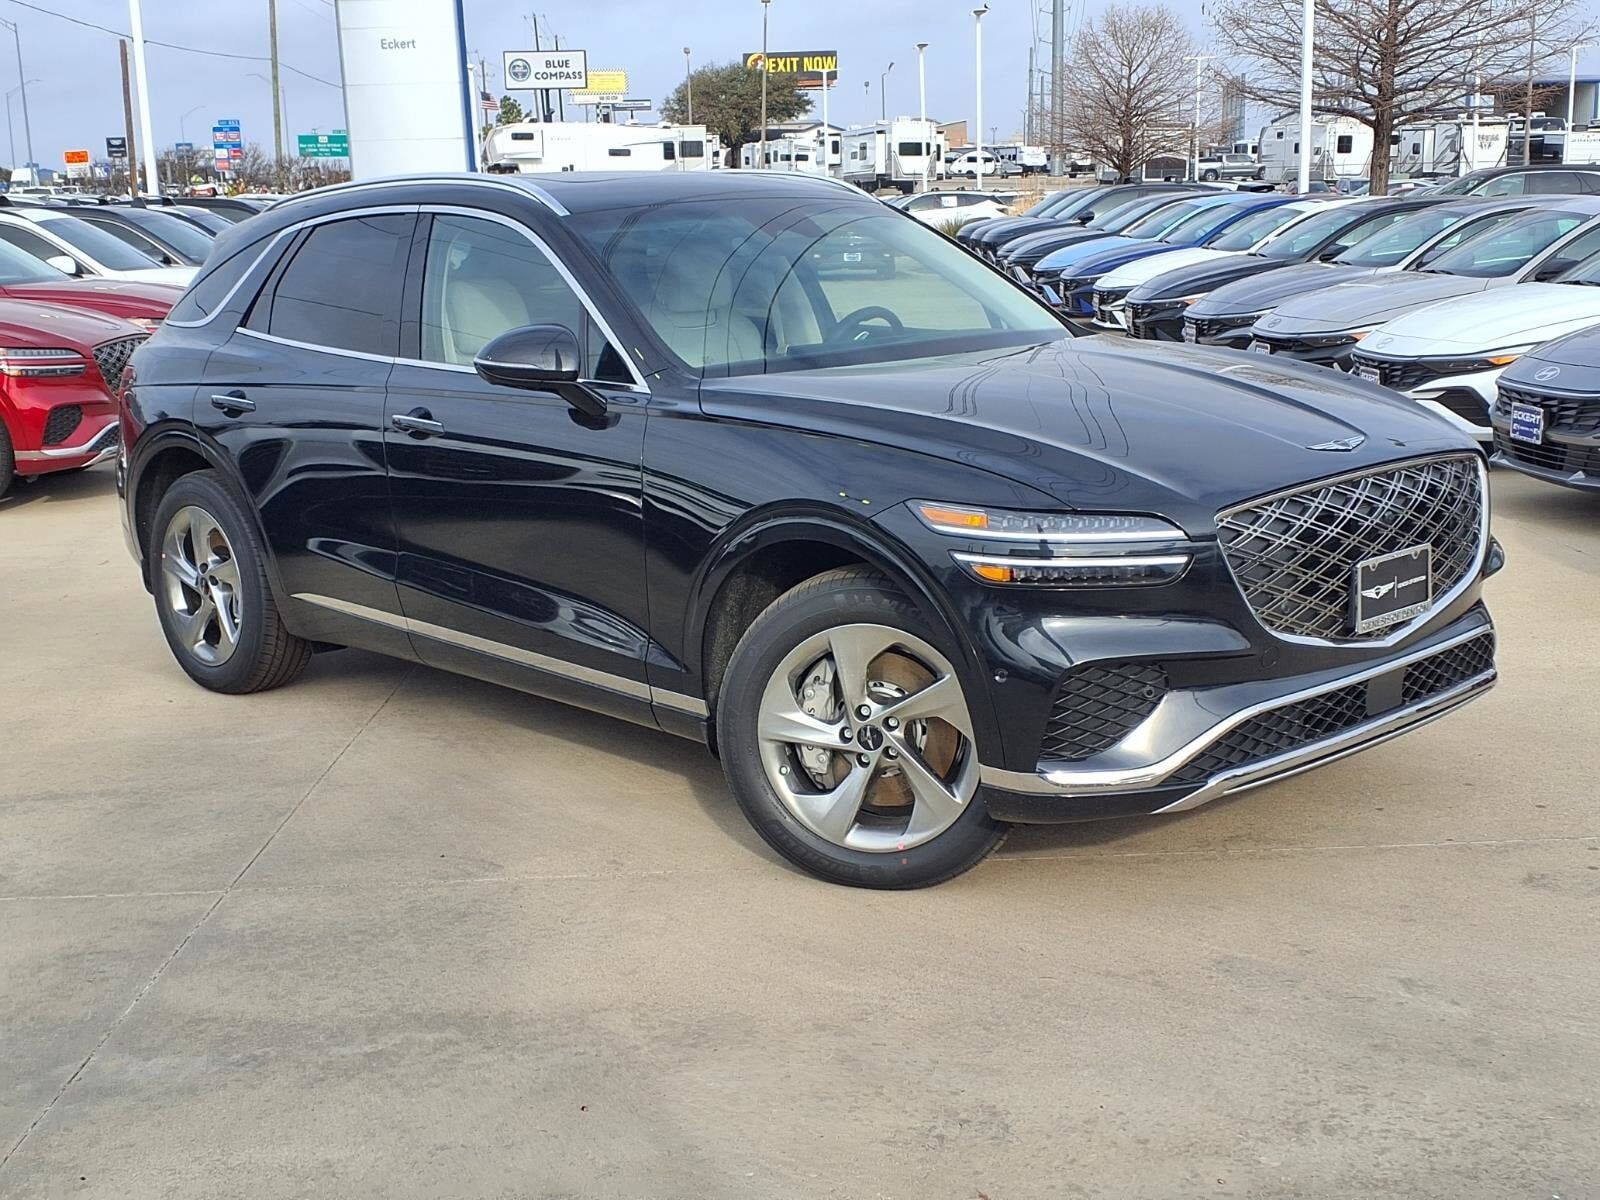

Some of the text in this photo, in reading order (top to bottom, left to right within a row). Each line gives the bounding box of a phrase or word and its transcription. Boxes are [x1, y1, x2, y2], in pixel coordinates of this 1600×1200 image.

[380, 38, 416, 50] Eckert
[545, 59, 570, 69] BLUE
[768, 55, 836, 73] EXIT NOW
[534, 71, 583, 80] COMPASS
[1513, 410, 1541, 425] ECKERT
